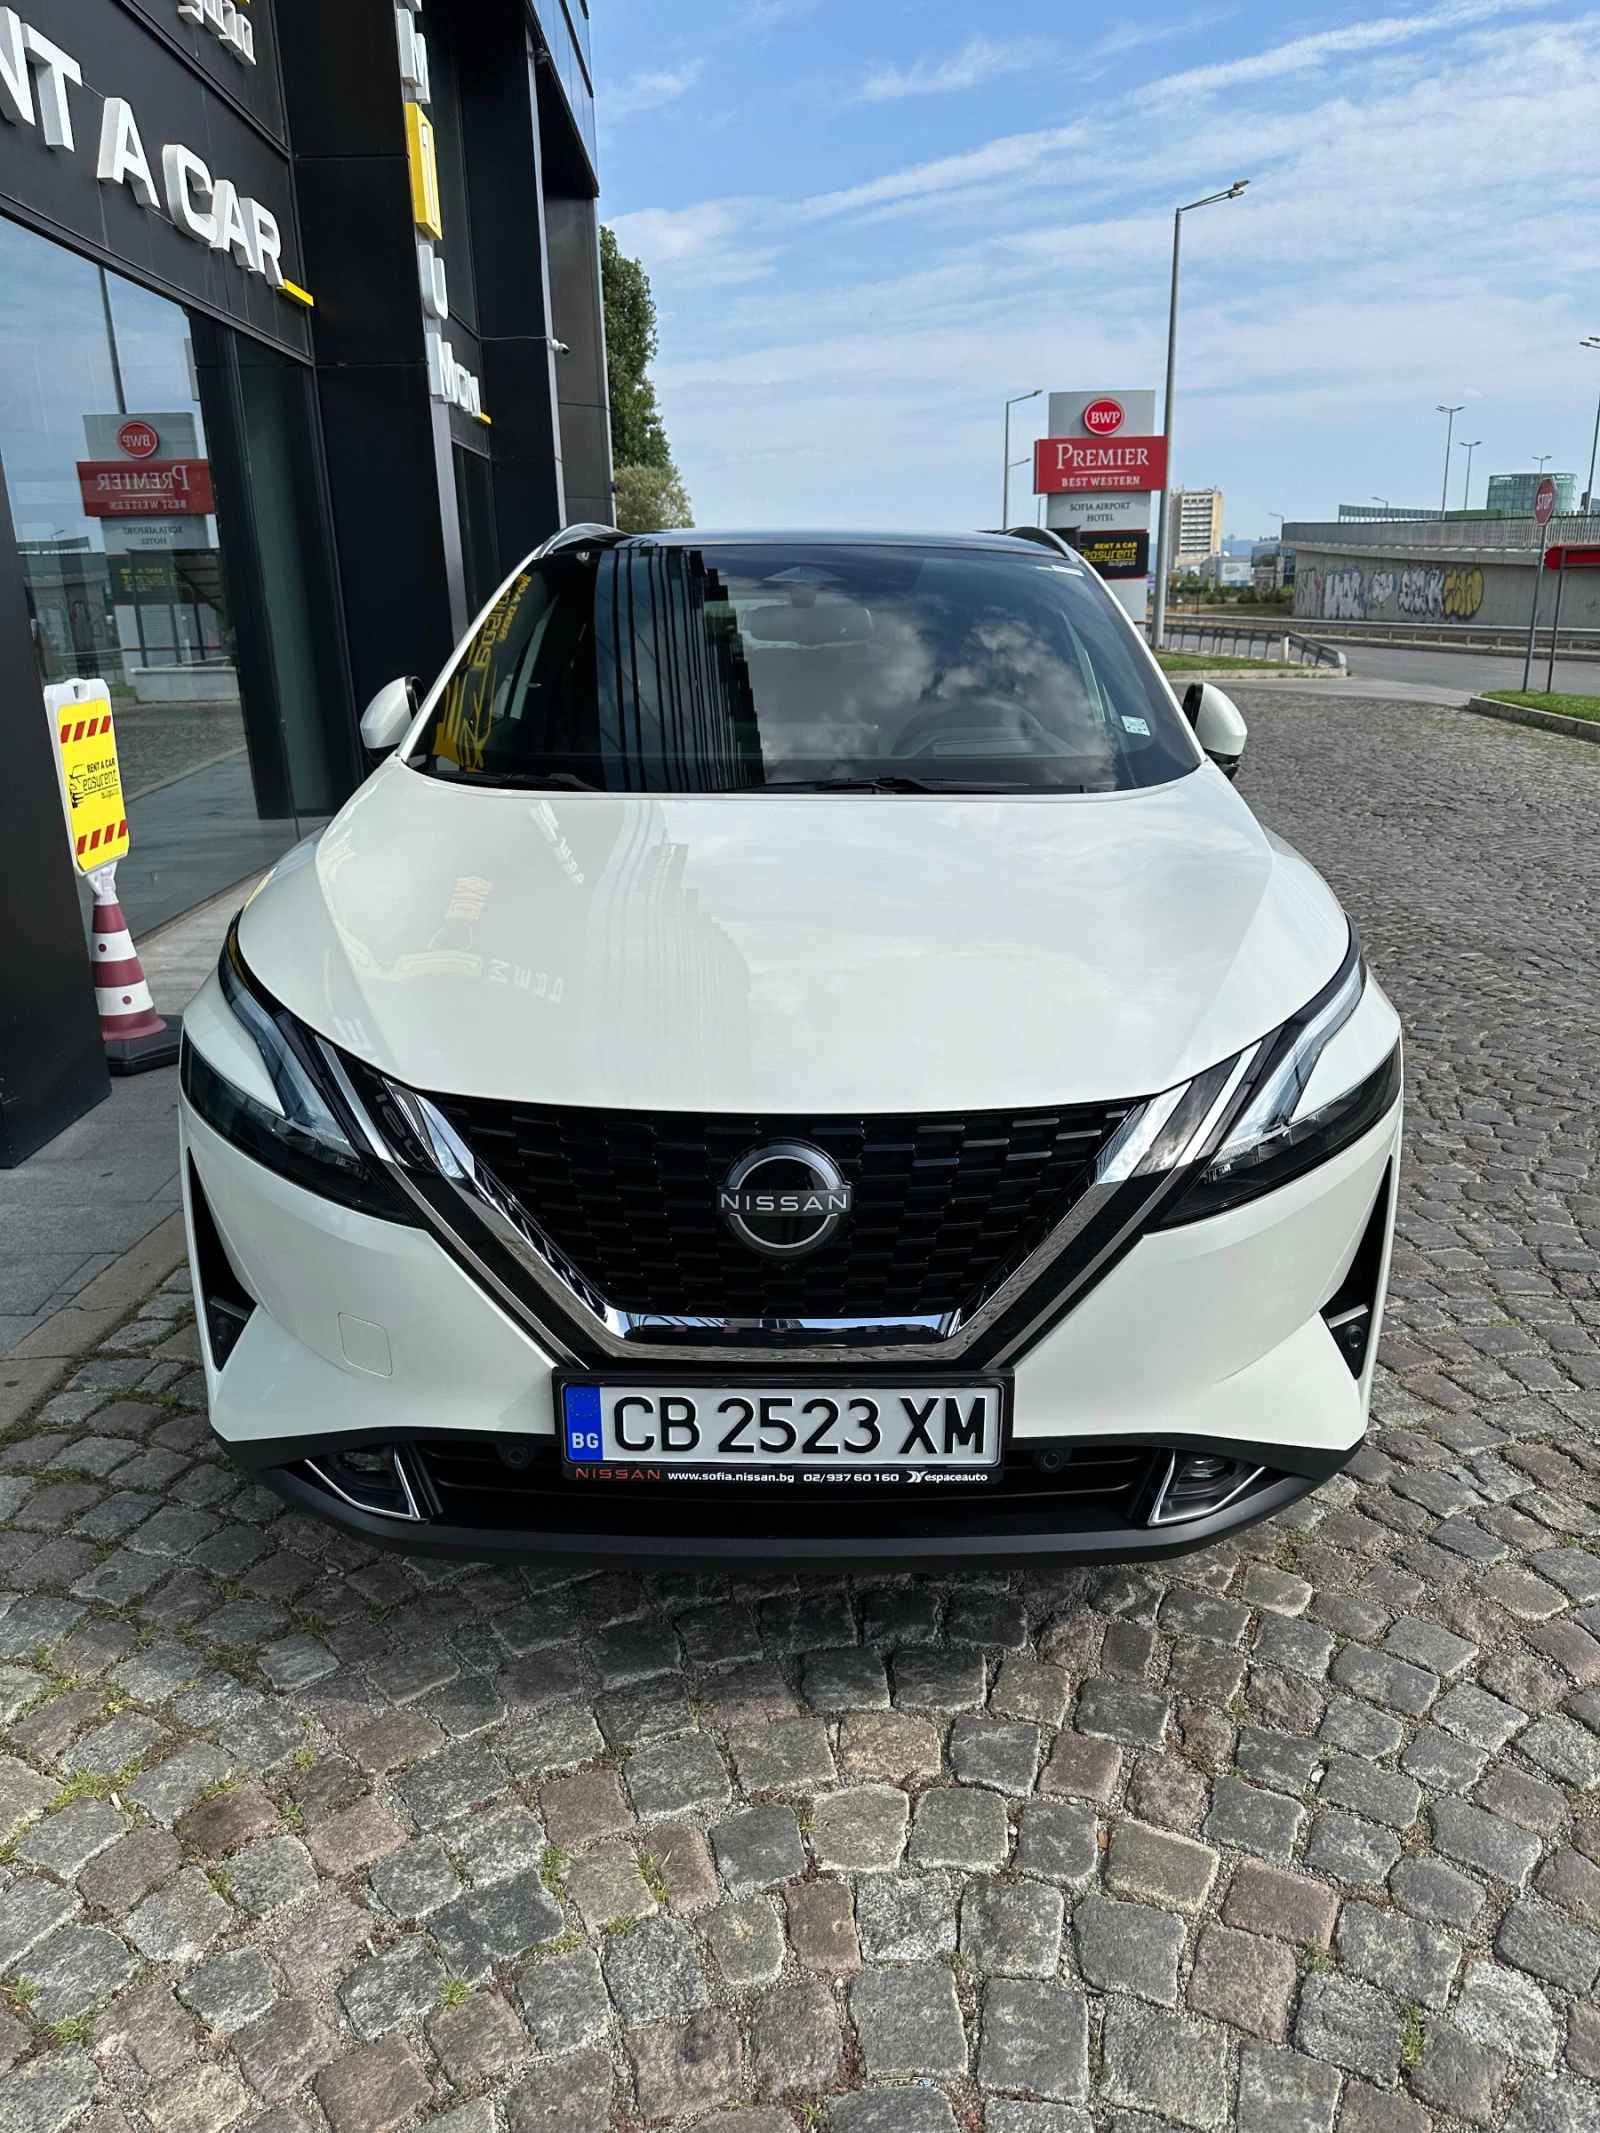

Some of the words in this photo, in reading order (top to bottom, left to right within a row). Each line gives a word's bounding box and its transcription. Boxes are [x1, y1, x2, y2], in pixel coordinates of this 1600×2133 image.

[97, 97, 161, 209] A
[162, 144, 287, 289] CAR
[1091, 411, 1120, 424] BWP
[1056, 444, 1149, 469] PREMIER
[1062, 478, 1088, 487] BEST
[1090, 476, 1140, 487] WESTERN
[1069, 503, 1095, 511] SOFIA
[1095, 502, 1131, 511] AIRPORT
[1536, 493, 1553, 510] STOP
[1087, 514, 1115, 522] HOTEL
[1083, 549, 1137, 561] easyrent
[87, 761, 100, 774] RENT
[105, 757, 116, 768] CAR
[82, 769, 118, 791] easyrent
[720, 1193, 847, 1212] NISSAN
[571, 1432, 599, 1450] BG
[613, 1396, 700, 1452] CB
[717, 1396, 882, 1454] 2523
[898, 1396, 986, 1454] XM
[575, 1468, 661, 1480] NISSAN
[668, 1471, 795, 1483] www.sofia.nissan.bg
[924, 1472, 988, 1483] espaceauto
